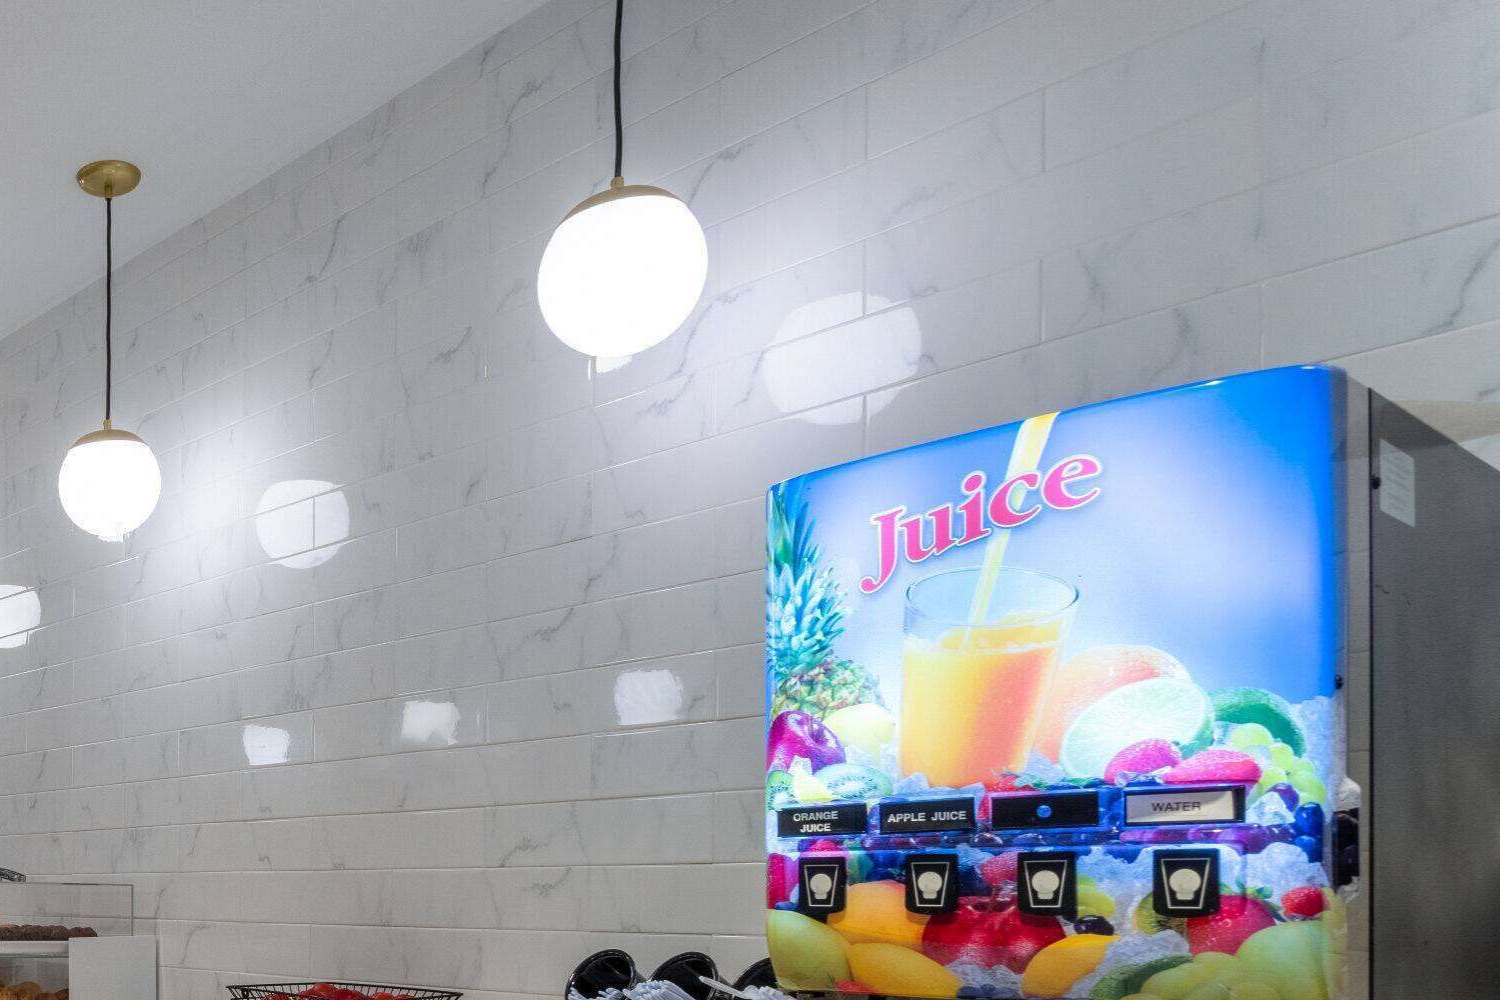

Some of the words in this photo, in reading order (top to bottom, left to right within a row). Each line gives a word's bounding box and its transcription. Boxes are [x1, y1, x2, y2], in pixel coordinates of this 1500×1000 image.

[859, 454, 1102, 594] Juice
[1151, 801, 1201, 812] WATER
[793, 811, 838, 822] ORANGE
[887, 812, 926, 823] APPLE
[931, 811, 967, 821] JUICE
[800, 823, 831, 833] JUICE
